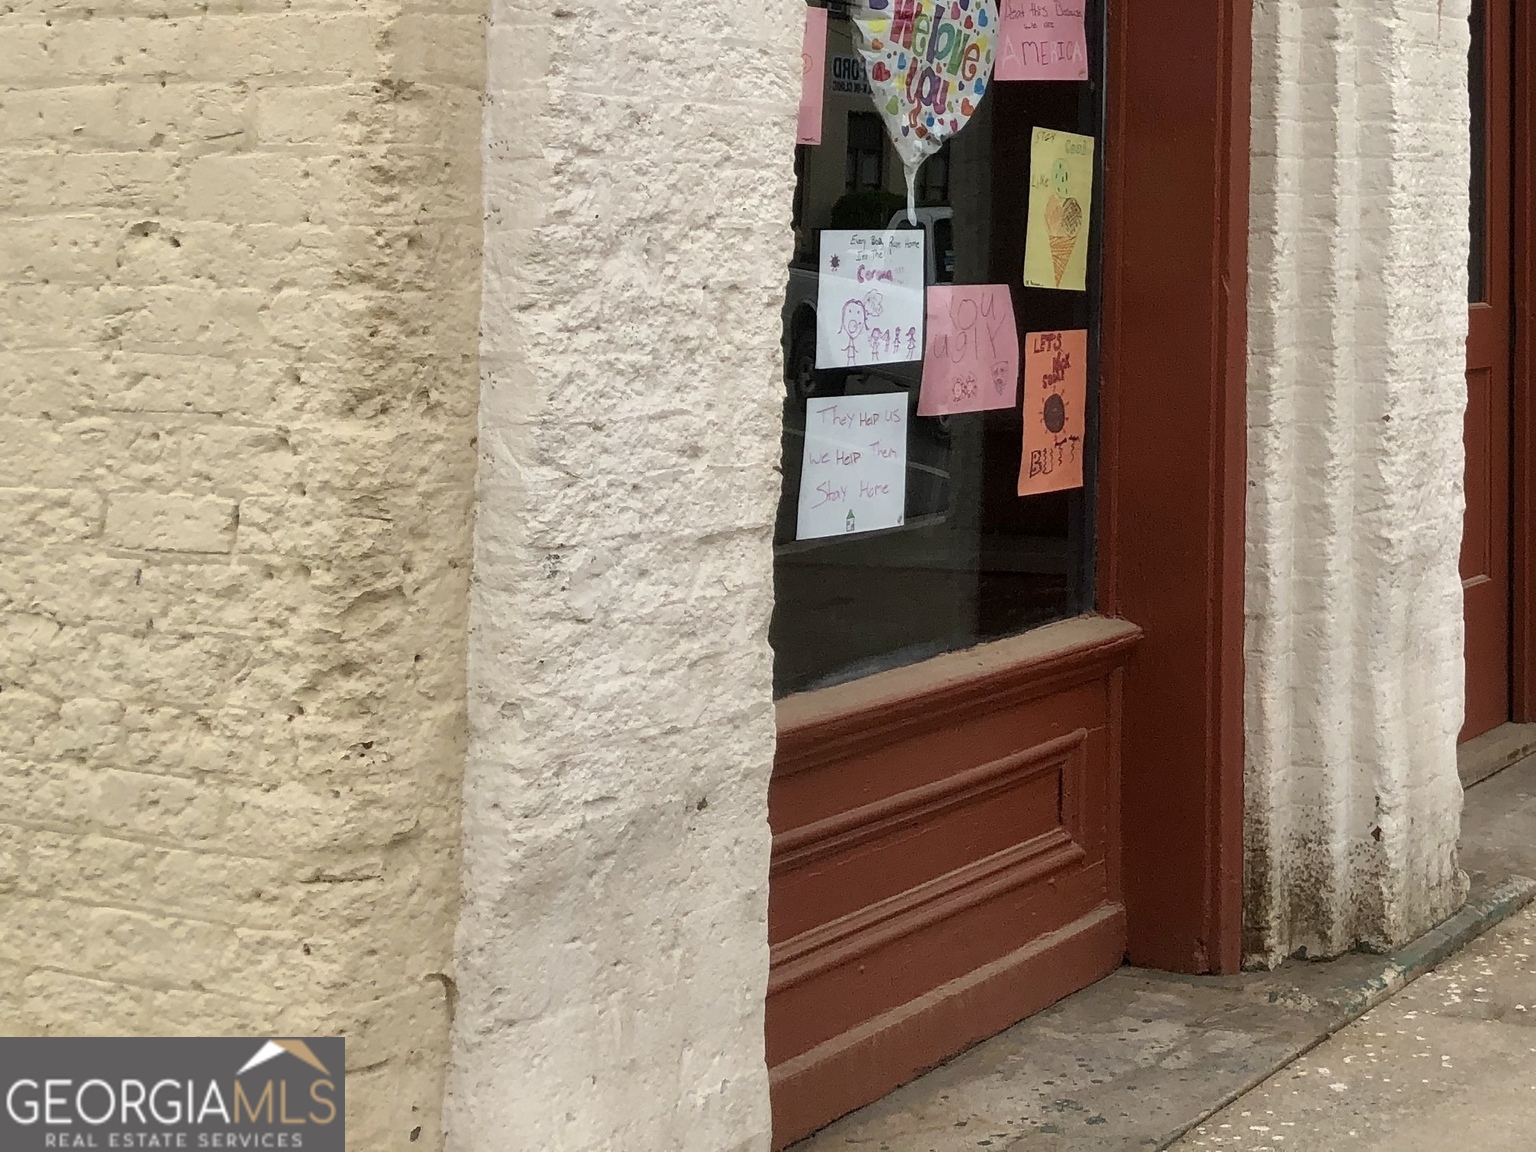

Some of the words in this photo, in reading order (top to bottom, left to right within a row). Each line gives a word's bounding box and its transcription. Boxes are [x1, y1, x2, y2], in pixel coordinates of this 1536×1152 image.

[926, 4, 980, 81] love
[1002, 34, 1083, 69] AMERICA
[816, 405, 855, 429] They
[811, 480, 848, 509] Stay
